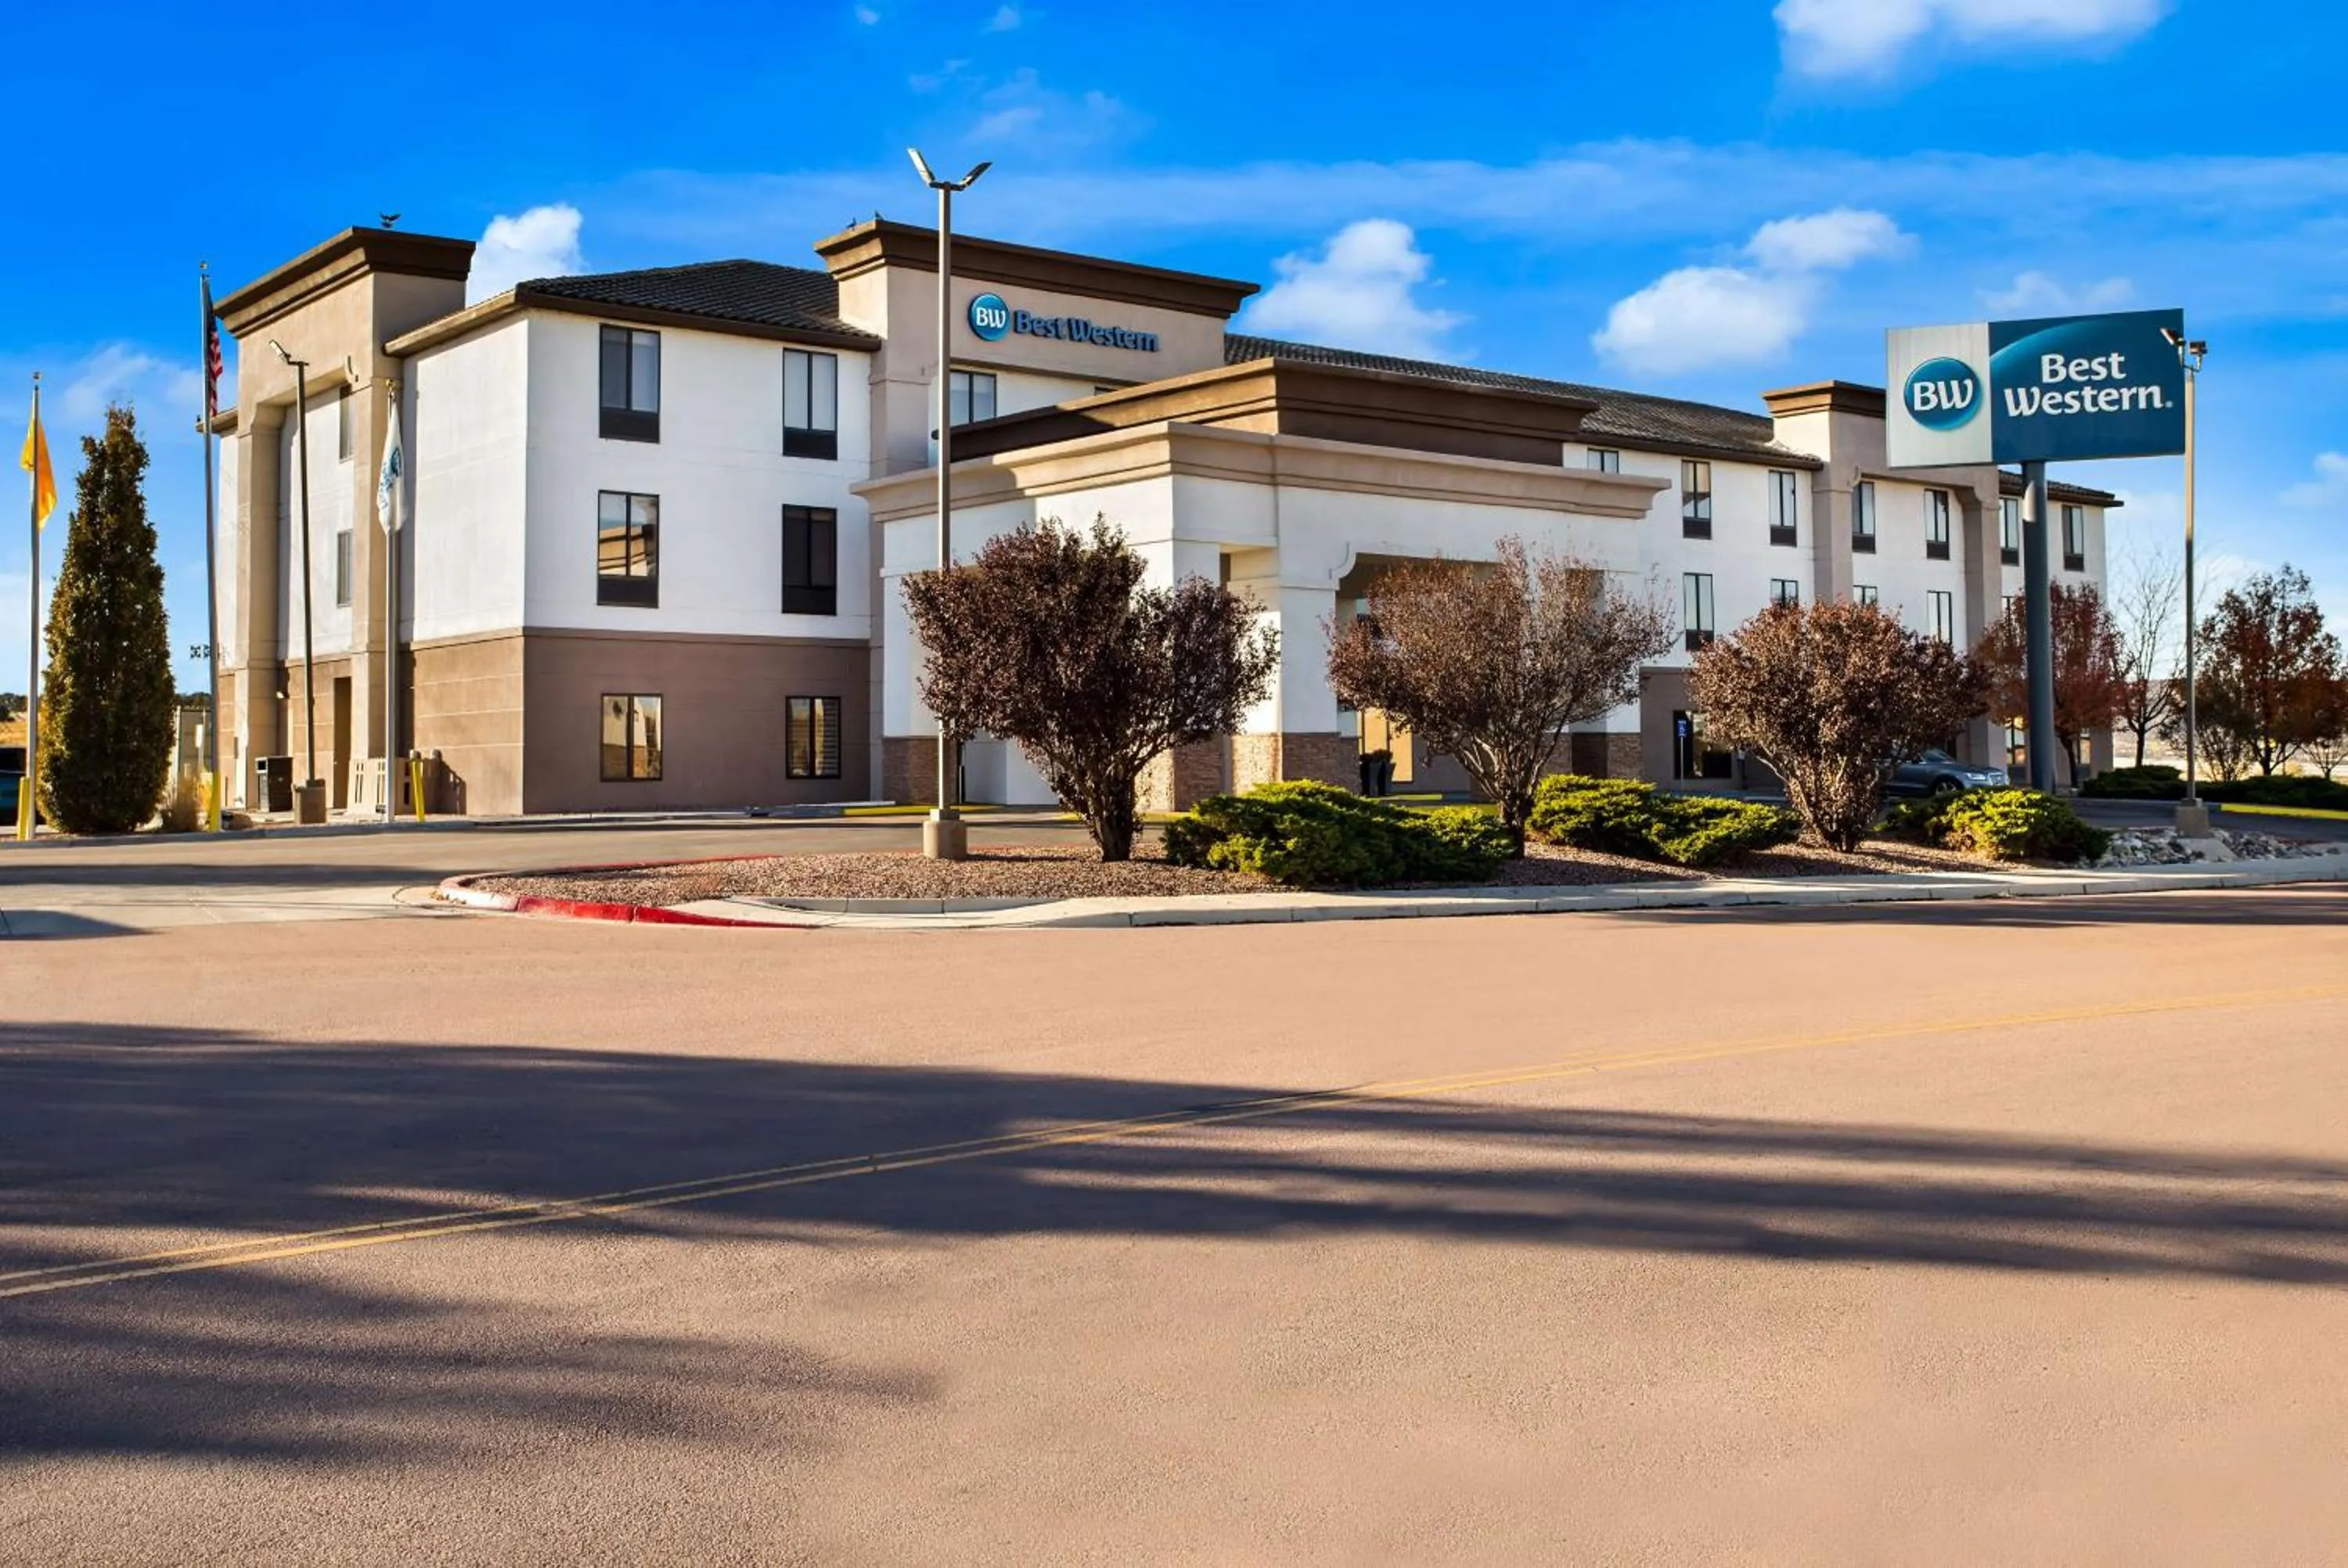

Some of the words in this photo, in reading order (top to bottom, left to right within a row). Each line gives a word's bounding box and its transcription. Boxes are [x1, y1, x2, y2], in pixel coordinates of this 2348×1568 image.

[975, 306, 1007, 329] BW
[1014, 309, 1068, 340] Best
[1068, 317, 1159, 352] Western
[2040, 351, 2127, 383] Best
[1912, 378, 1974, 412] BW
